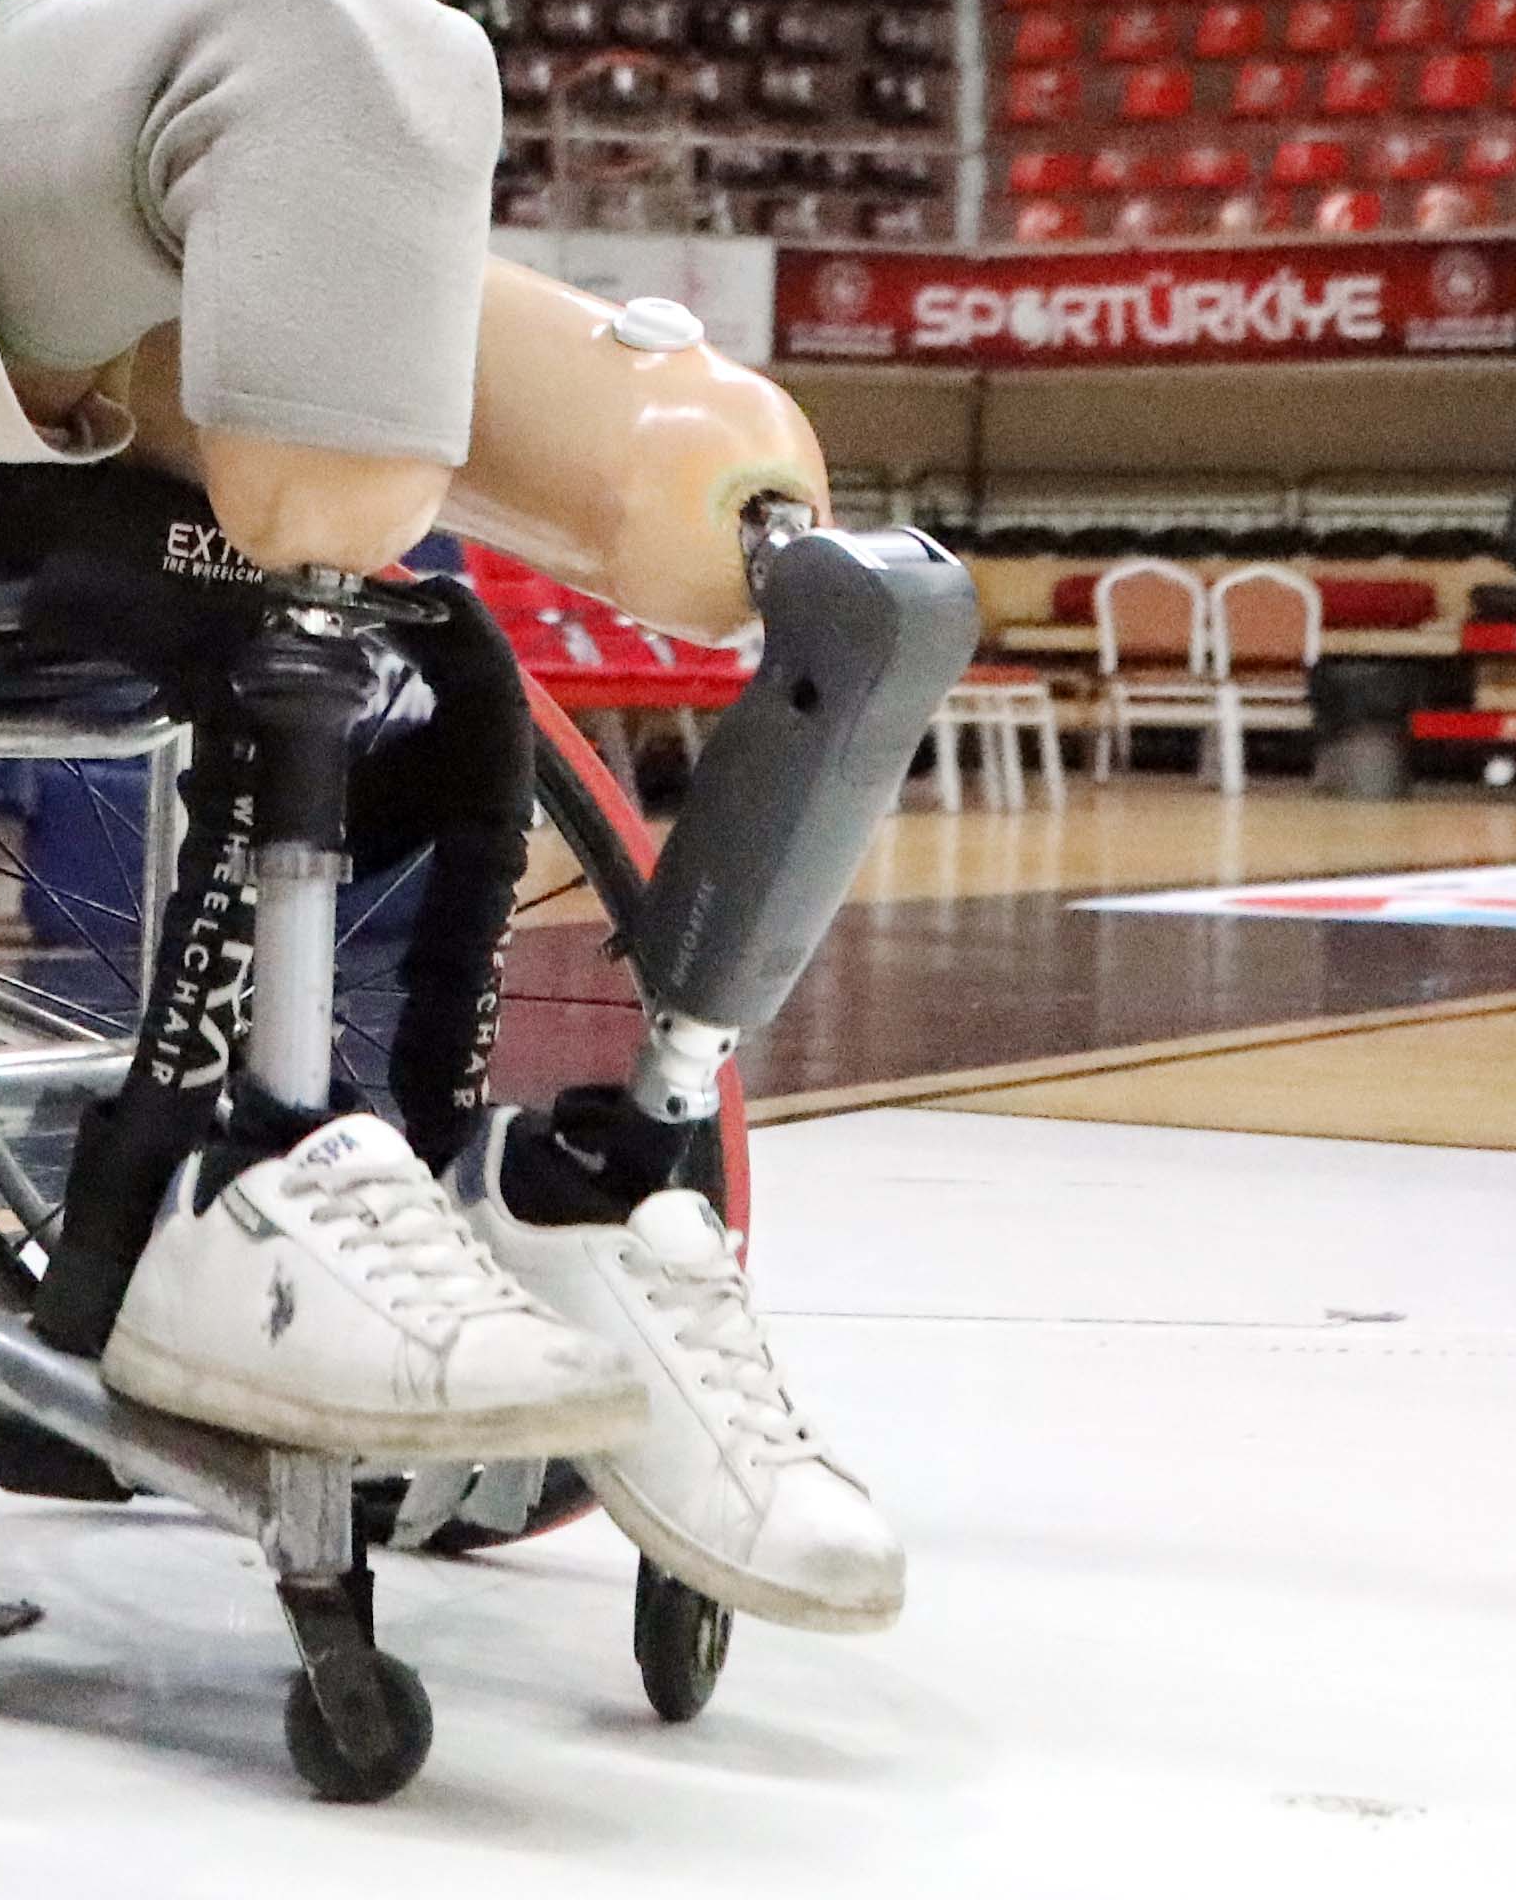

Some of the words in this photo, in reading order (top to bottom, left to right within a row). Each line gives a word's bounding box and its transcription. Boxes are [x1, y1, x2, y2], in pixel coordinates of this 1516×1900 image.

[163, 555, 187, 575] THE
[192, 560, 264, 584] WHEELCHA
[151, 795, 254, 1086] WHEELCHAIR
